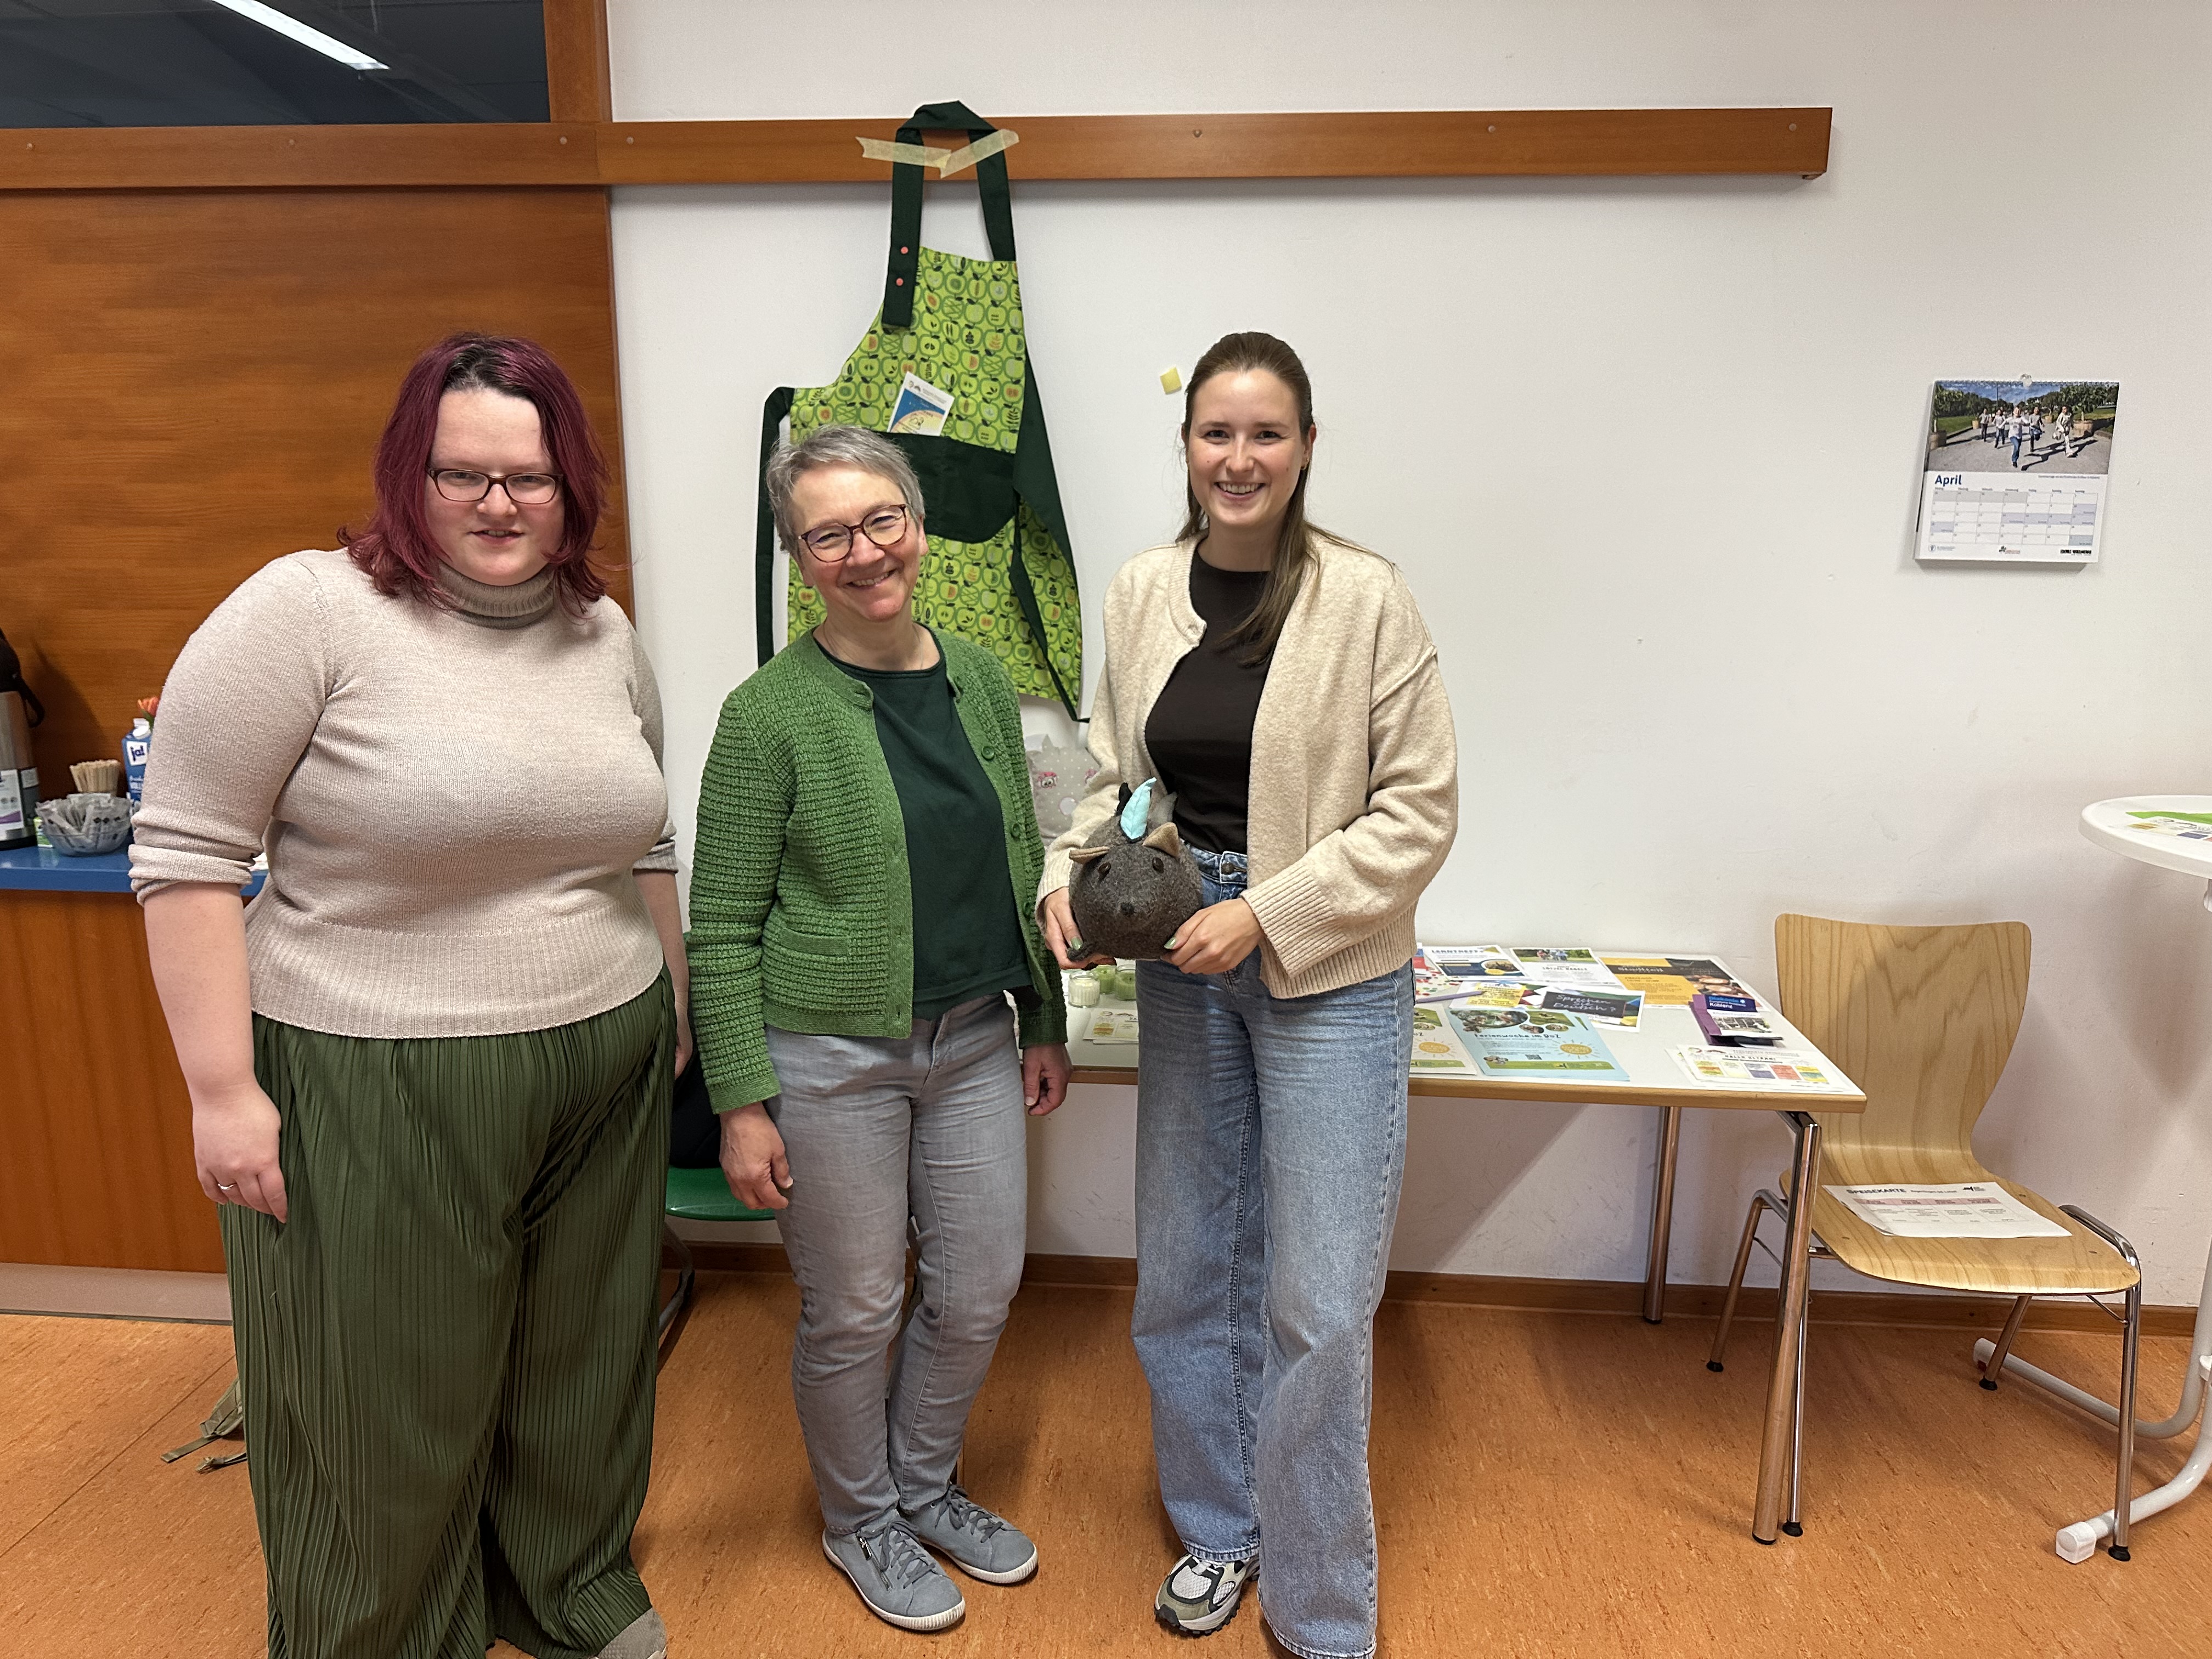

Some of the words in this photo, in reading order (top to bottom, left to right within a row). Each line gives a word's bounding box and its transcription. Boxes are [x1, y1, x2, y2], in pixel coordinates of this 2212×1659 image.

[1934, 475, 1962, 487] April
[1556, 994, 1611, 1004] Sprechen
[1553, 1002, 1607, 1011] Deutsch
